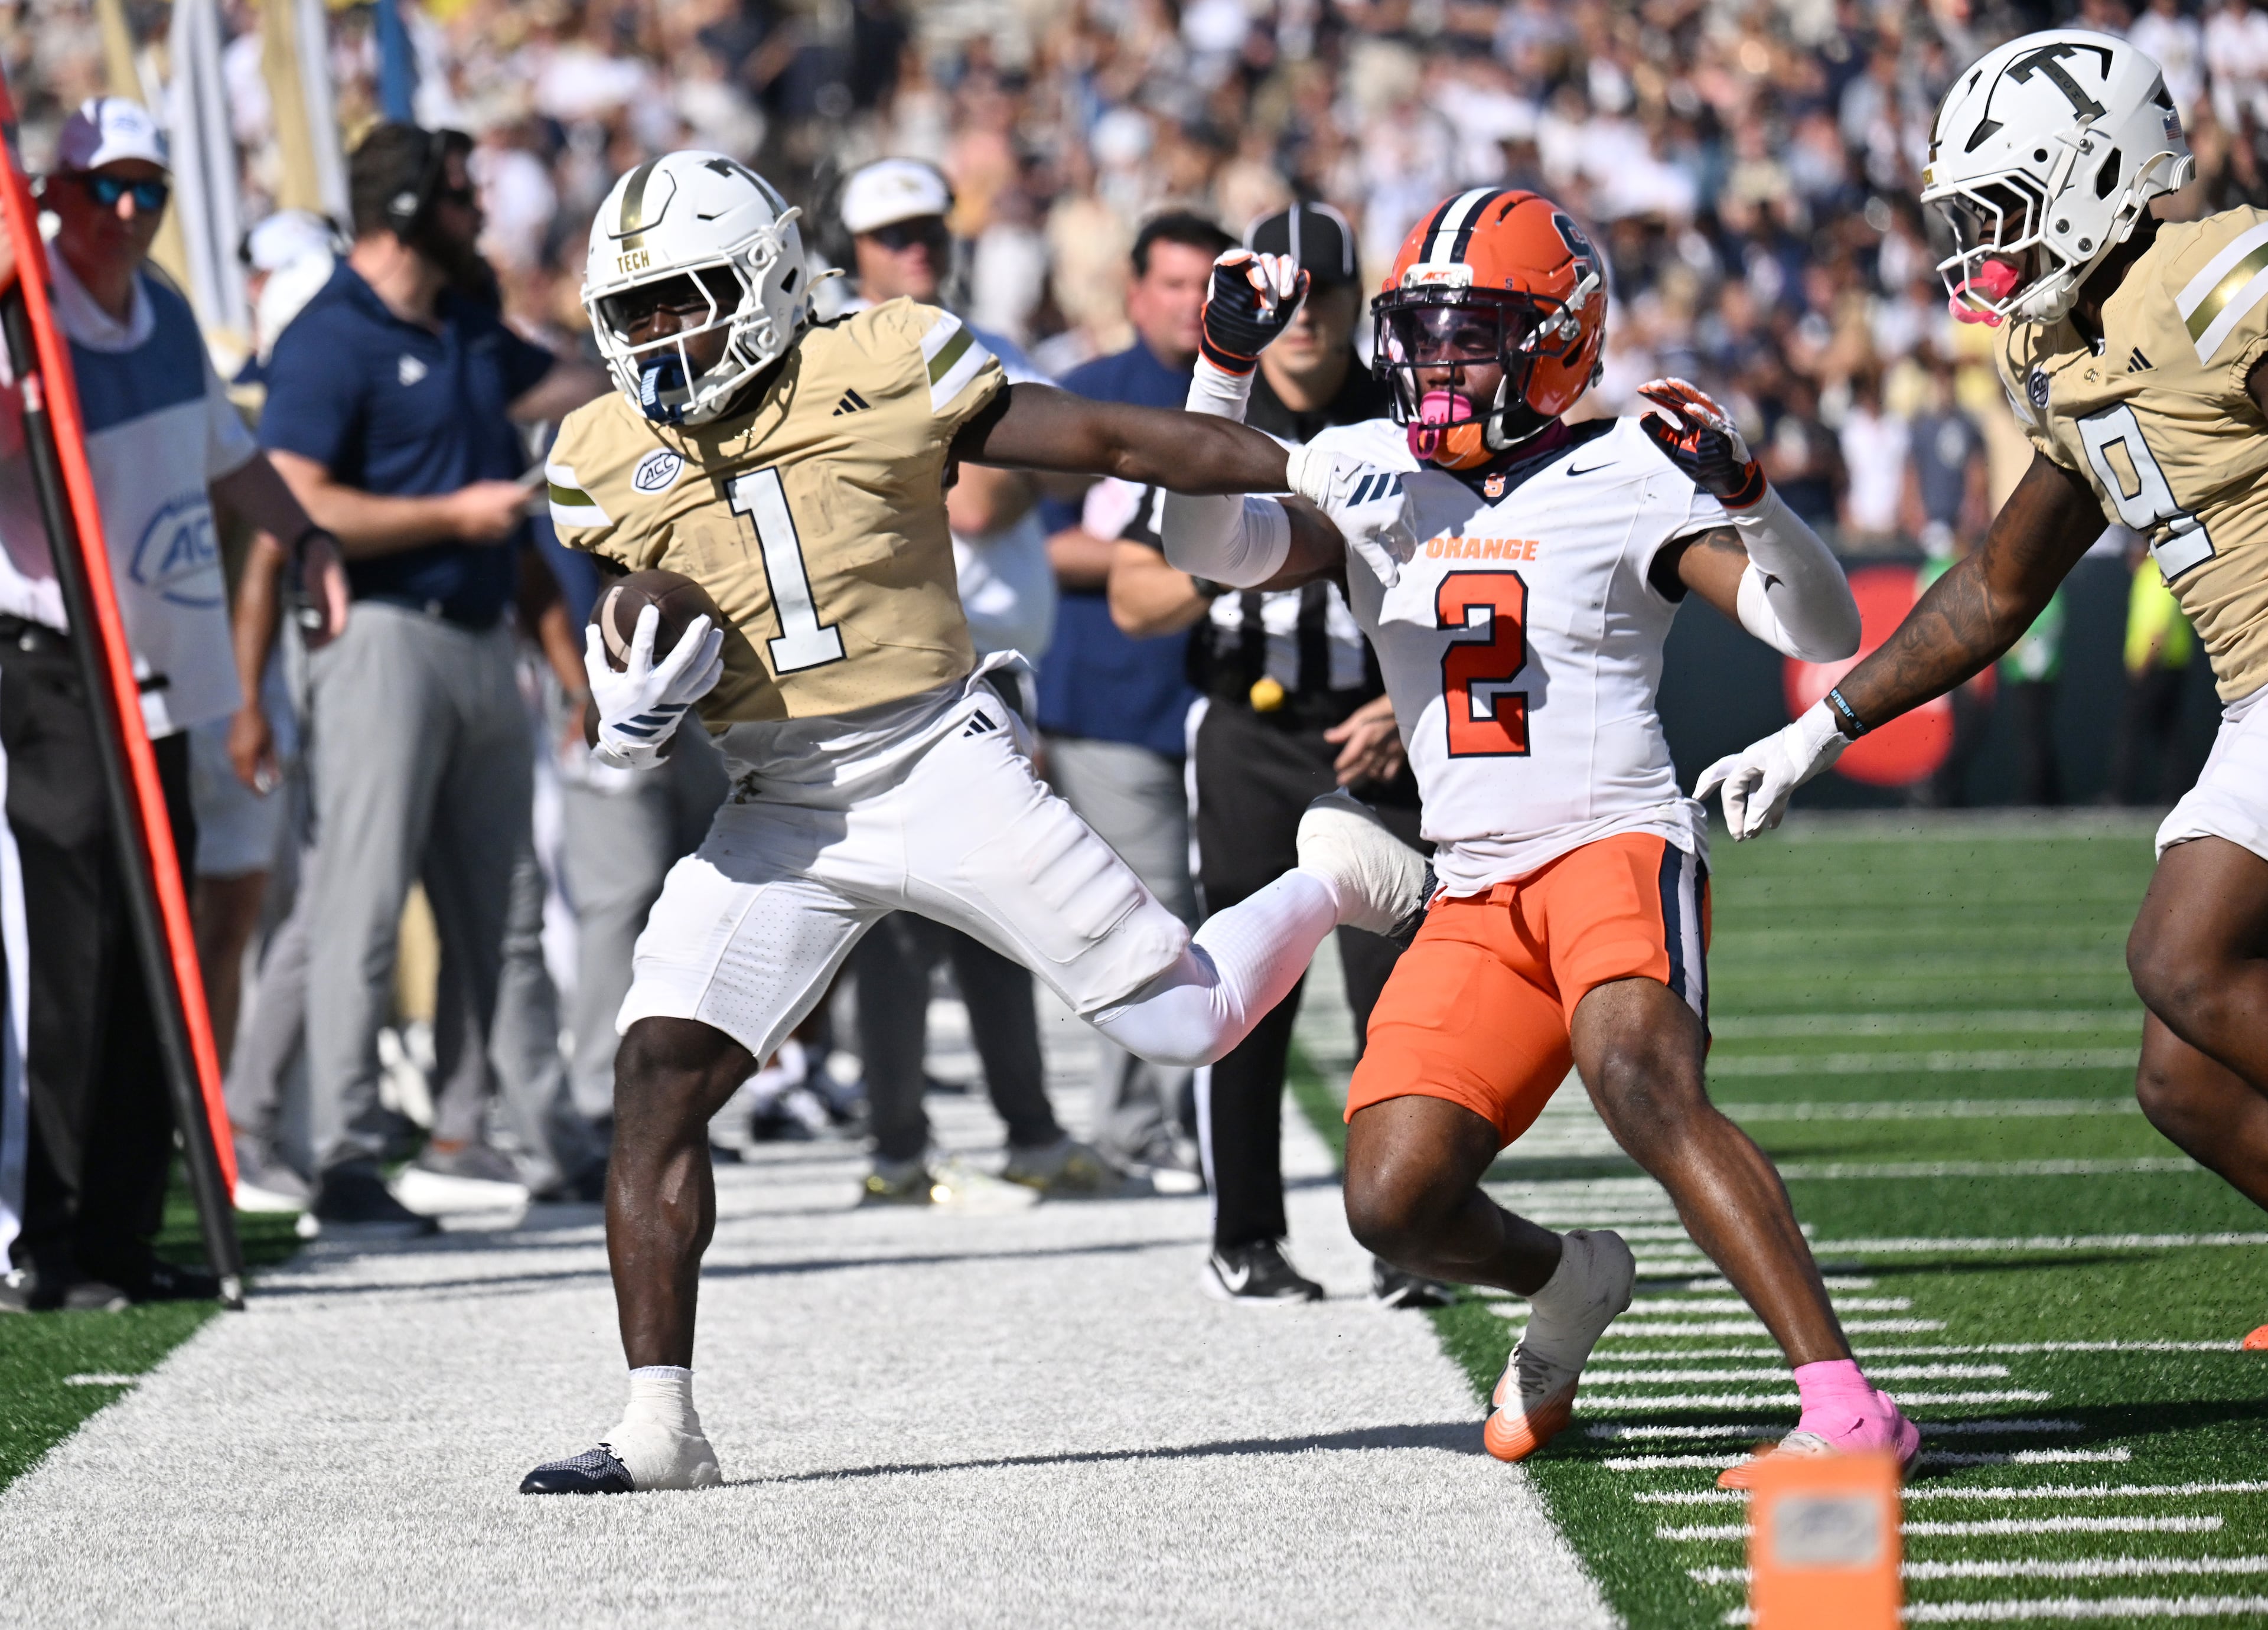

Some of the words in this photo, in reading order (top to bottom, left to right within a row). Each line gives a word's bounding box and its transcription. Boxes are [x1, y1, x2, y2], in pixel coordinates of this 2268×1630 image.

[2045, 63, 2081, 100] TECH
[617, 250, 650, 274] TECH
[1421, 271, 1452, 281] ACC
[644, 454, 674, 483] ACC
[1484, 473, 1506, 497] S
[1425, 537, 1540, 562] ORANGE
[722, 465, 847, 676] 1
[1434, 570, 1531, 759] 2
[1830, 689, 1855, 718] JESUS
